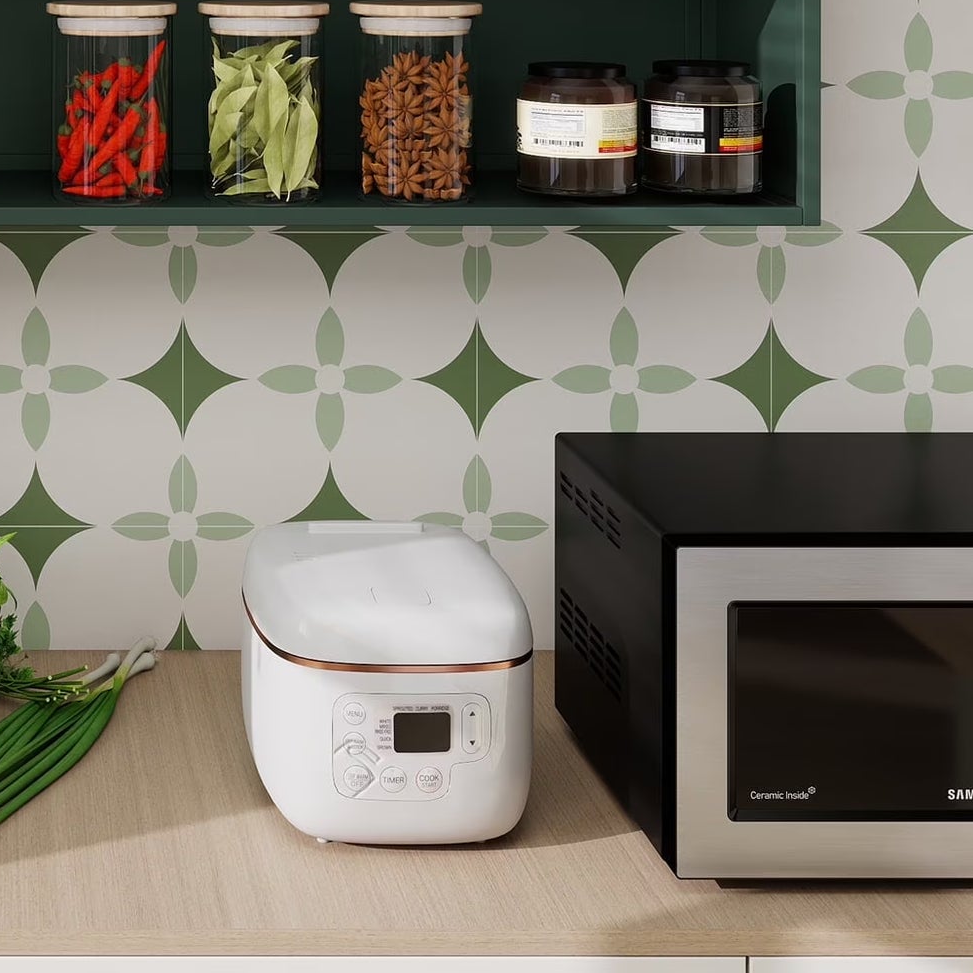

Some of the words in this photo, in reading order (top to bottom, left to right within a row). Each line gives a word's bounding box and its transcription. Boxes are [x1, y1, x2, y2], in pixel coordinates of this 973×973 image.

[383, 776, 405, 784] TIMER
[750, 790, 784, 800] Ceramic
[785, 790, 810, 800] Inside
